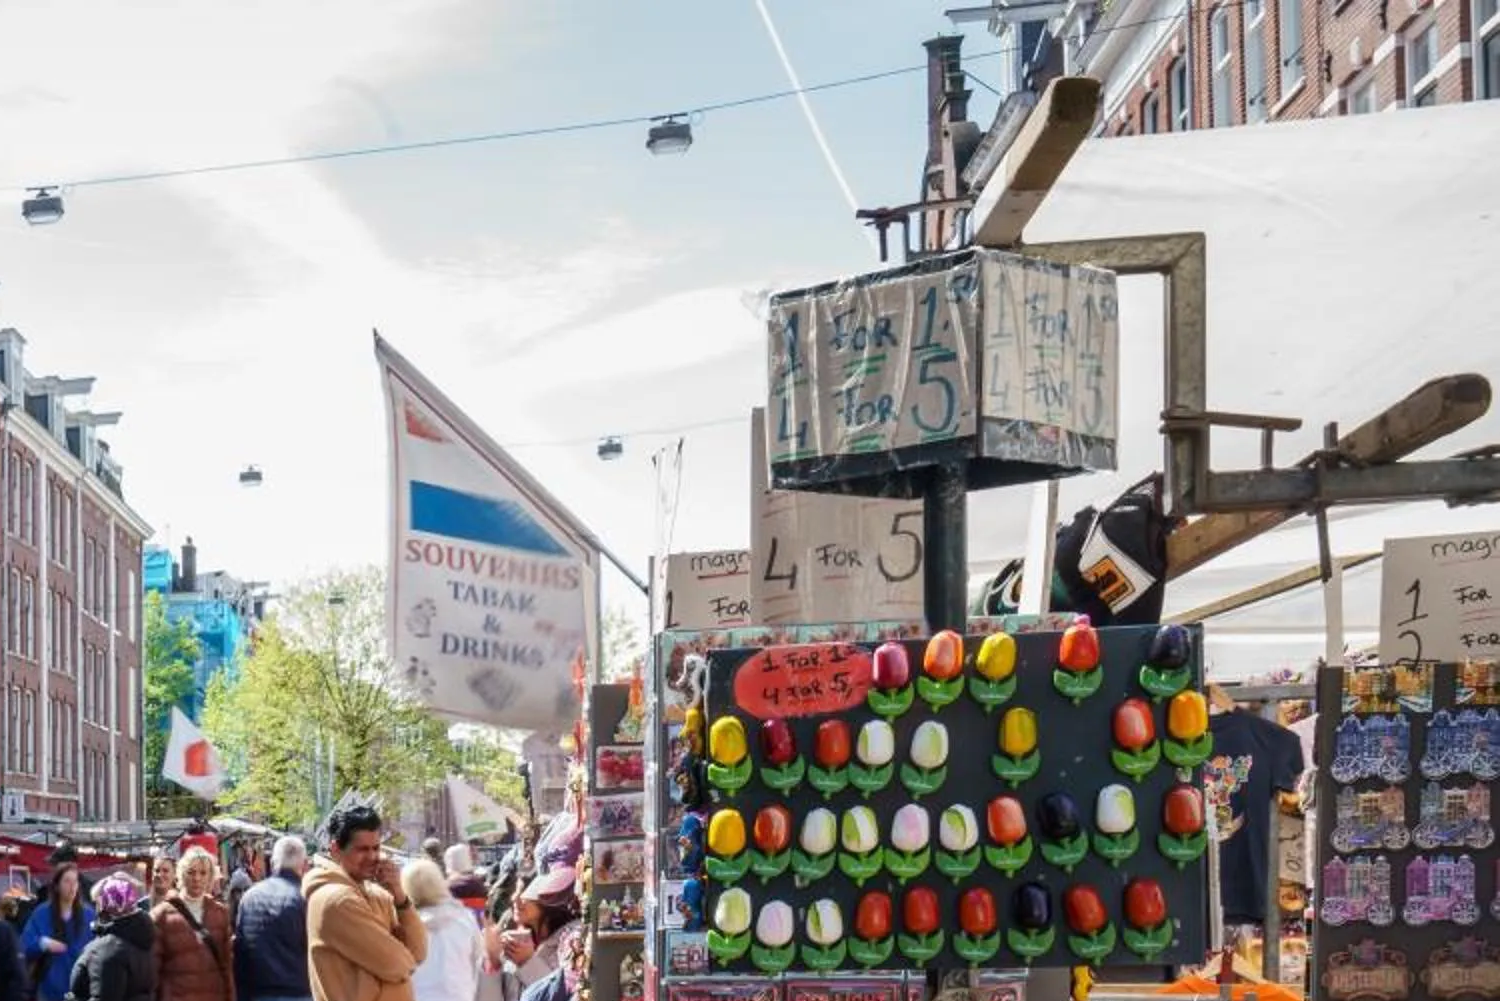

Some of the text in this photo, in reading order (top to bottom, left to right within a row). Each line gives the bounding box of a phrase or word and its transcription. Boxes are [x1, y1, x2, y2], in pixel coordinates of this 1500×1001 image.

[830, 308, 898, 352] FOR
[778, 397, 808, 448] 4
[832, 383, 900, 428] FOR
[405, 538, 580, 590] SOUVENIRS
[763, 510, 924, 589] 4 FOR 5
[447, 580, 536, 614] TABAK
[709, 594, 752, 618] FOR
[1453, 585, 1493, 604] FOR
[482, 613, 502, 634] &
[440, 632, 546, 670] DRINKS
[785, 652, 822, 668] FOR
